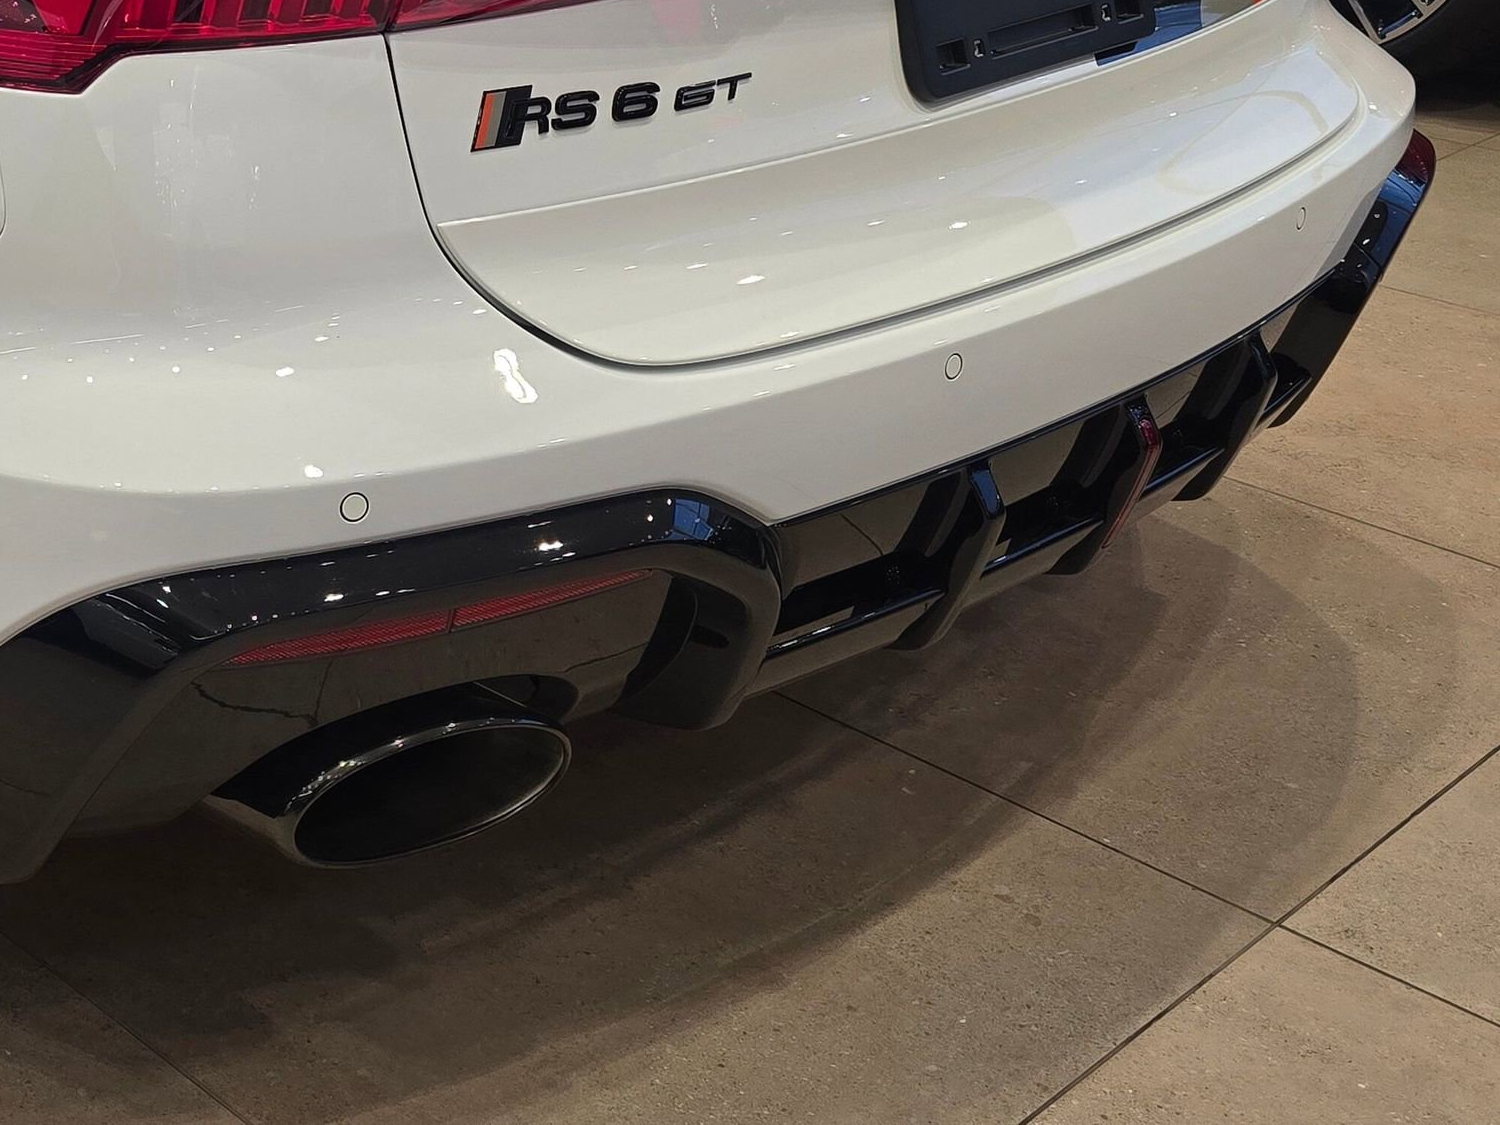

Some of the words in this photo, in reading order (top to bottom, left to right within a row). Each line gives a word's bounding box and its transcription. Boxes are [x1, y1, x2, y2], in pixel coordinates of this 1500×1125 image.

[500, 88, 600, 140] RS
[611, 81, 661, 122] 6
[674, 72, 752, 112] GT
